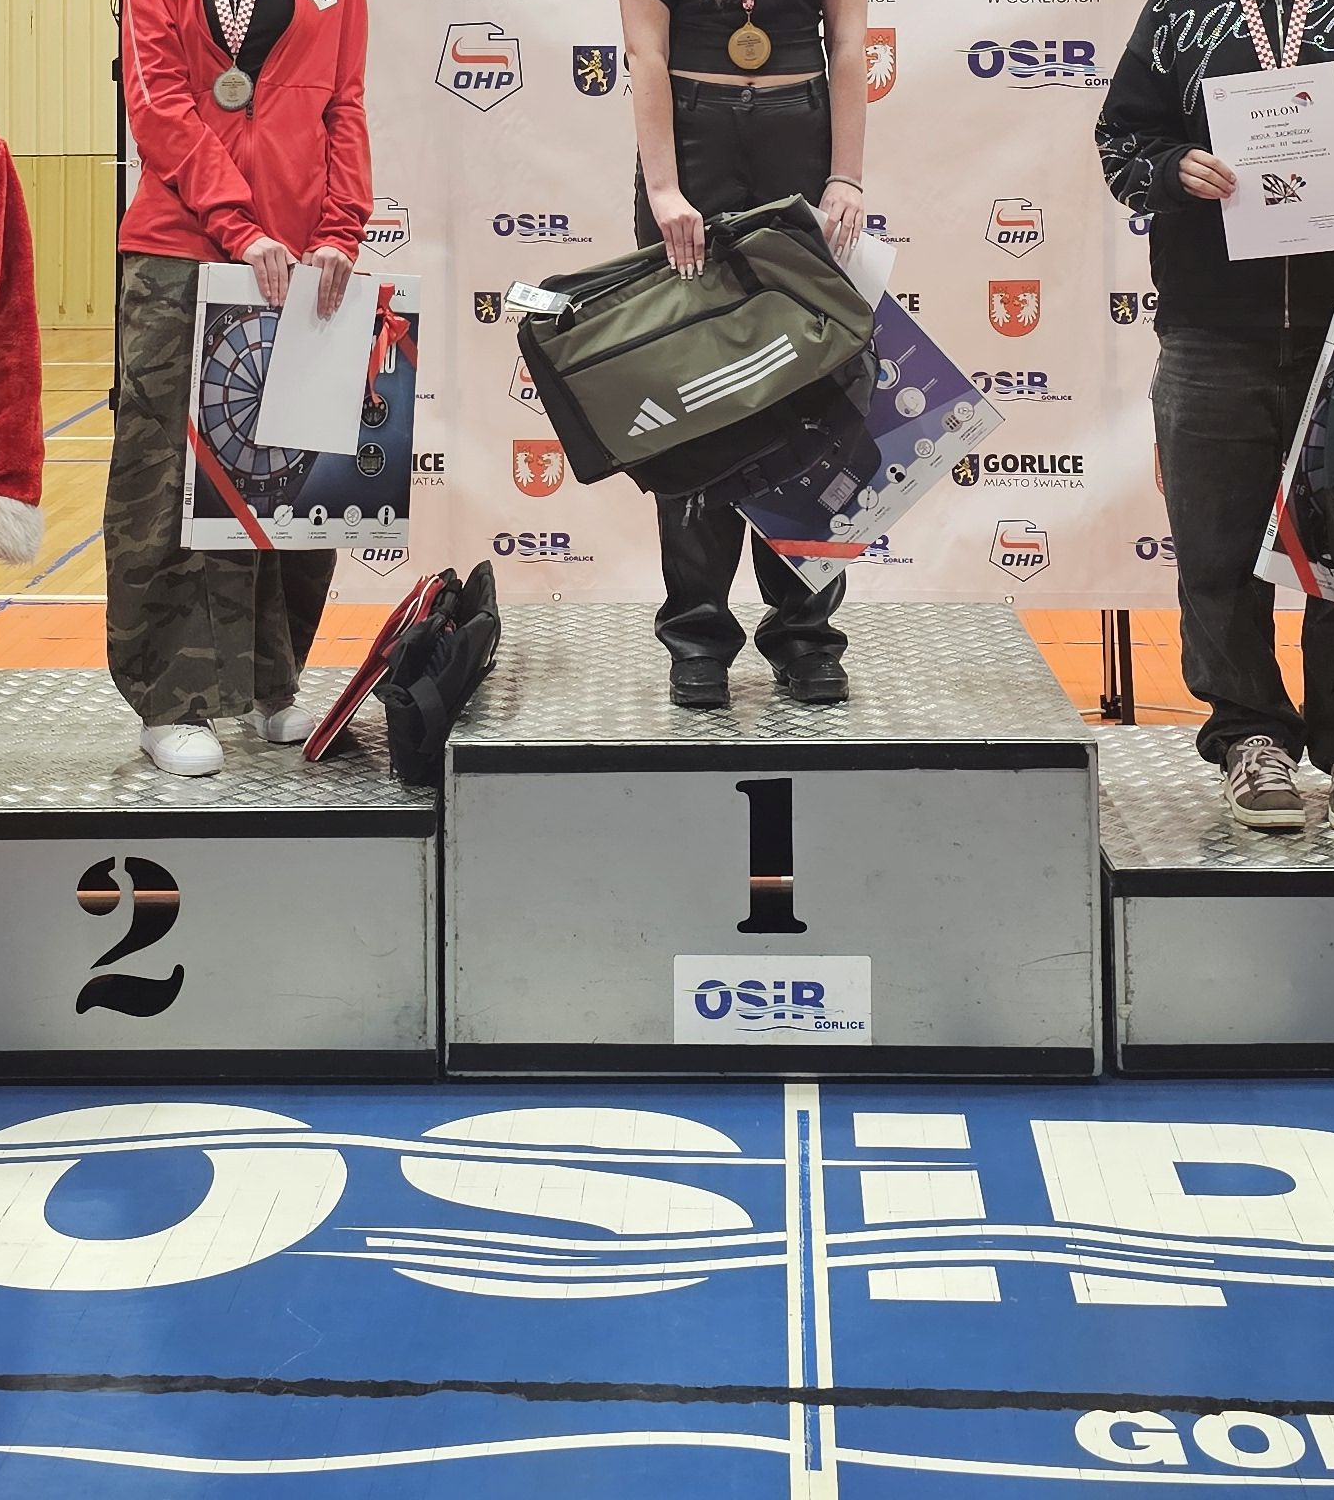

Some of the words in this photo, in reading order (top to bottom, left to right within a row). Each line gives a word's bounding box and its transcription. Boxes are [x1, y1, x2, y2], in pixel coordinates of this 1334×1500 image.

[967, 39, 1097, 79] OSiR
[453, 70, 515, 90] OHP
[1250, 105, 1300, 120] DYPLOM
[492, 213, 570, 237] OSiR
[997, 231, 1039, 244] OHP
[223, 314, 234, 325] 12
[207, 335, 214, 346] 9
[1327, 377, 1334, 389] 9
[298, 464, 304, 474] 2
[983, 454, 1084, 474] GORLICE
[259, 481, 265, 492] 3
[278, 476, 288, 487] 17
[983, 478, 1031, 489] MIASTO
[1033, 476, 1085, 490] ŚWIATŁA
[493, 532, 571, 556] OSiR
[362, 548, 404, 562] OHP
[1001, 553, 1044, 566] OHP
[735, 778, 808, 934] 1
[76, 856, 185, 1017] 2
[694, 980, 826, 1020] OSiR
[814, 1021, 865, 1031] GORLICE
